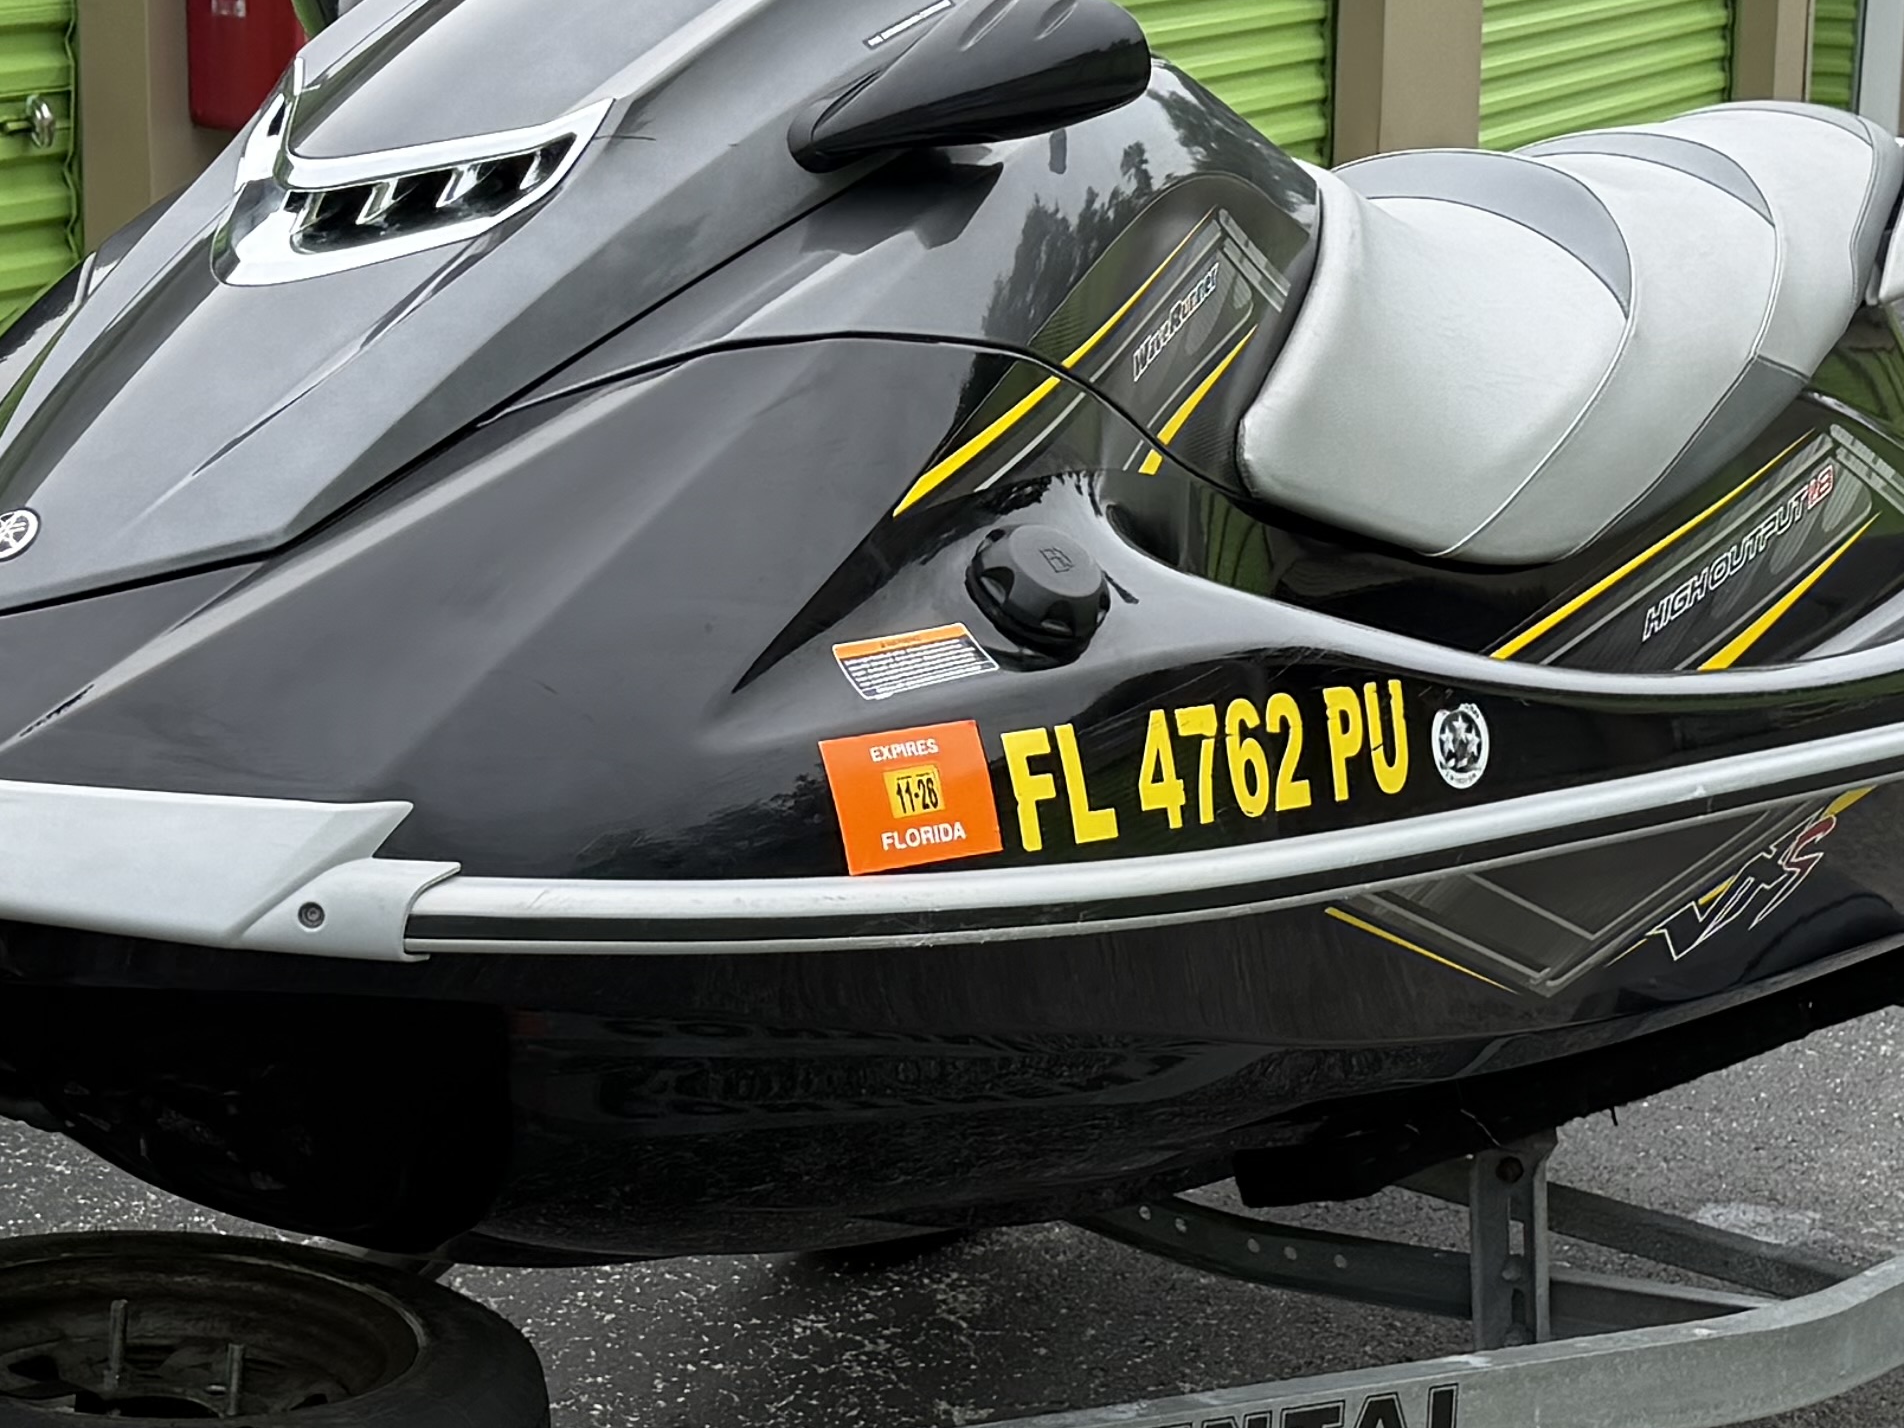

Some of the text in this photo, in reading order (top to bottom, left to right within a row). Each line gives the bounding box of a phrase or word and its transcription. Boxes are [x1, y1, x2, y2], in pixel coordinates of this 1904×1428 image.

[1642, 563, 1709, 642] HIGH
[1709, 483, 1809, 591] OUTPUT
[869, 738, 939, 763] EXPIRES
[1000, 723, 1119, 852] FL
[1138, 692, 1312, 830] 4762
[1322, 679, 1409, 802] PU
[881, 822, 966, 851] FLORIDA
